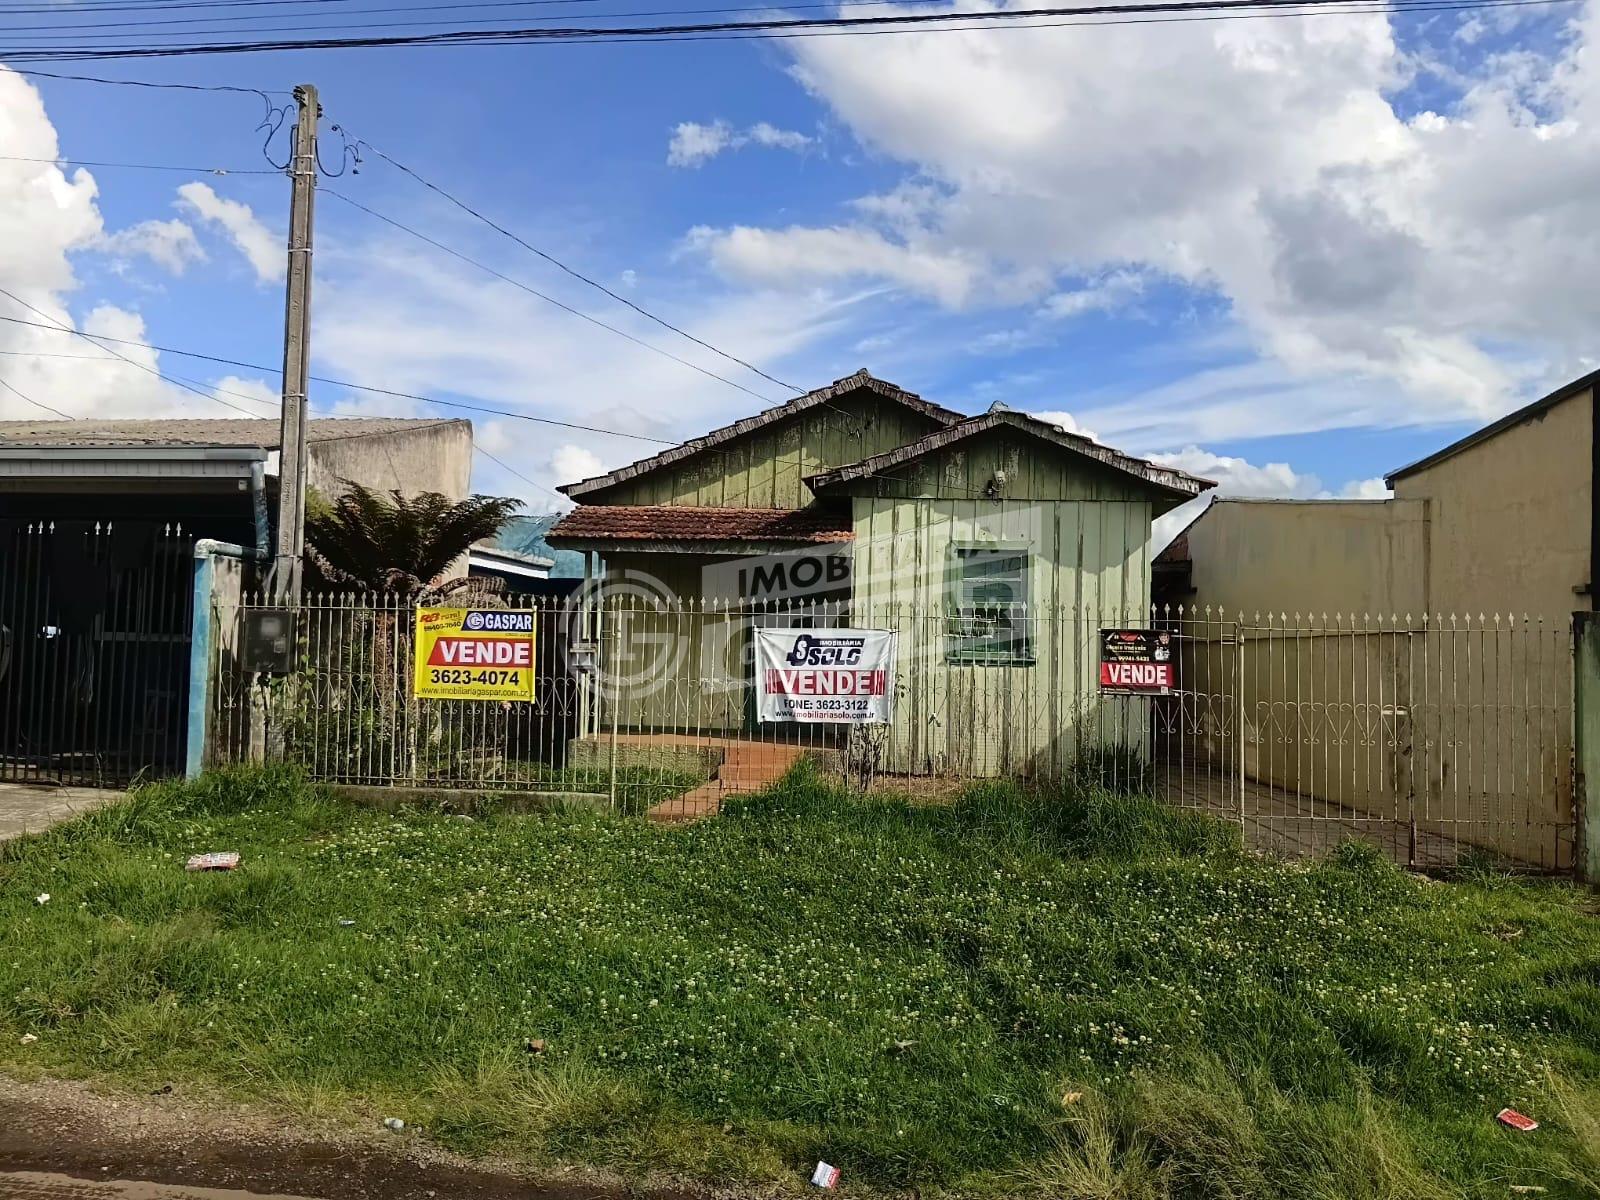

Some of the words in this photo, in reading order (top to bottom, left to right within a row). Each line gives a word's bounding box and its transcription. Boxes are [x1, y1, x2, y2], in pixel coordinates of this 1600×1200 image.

[485, 613, 532, 630] GASPAR
[440, 640, 530, 665] VENDE
[430, 669, 520, 686] 3623-4074
[779, 670, 872, 694] VENDE
[1107, 664, 1167, 684] VENDE
[784, 699, 813, 709] FONE:
[816, 700, 868, 711] 3623-3122
